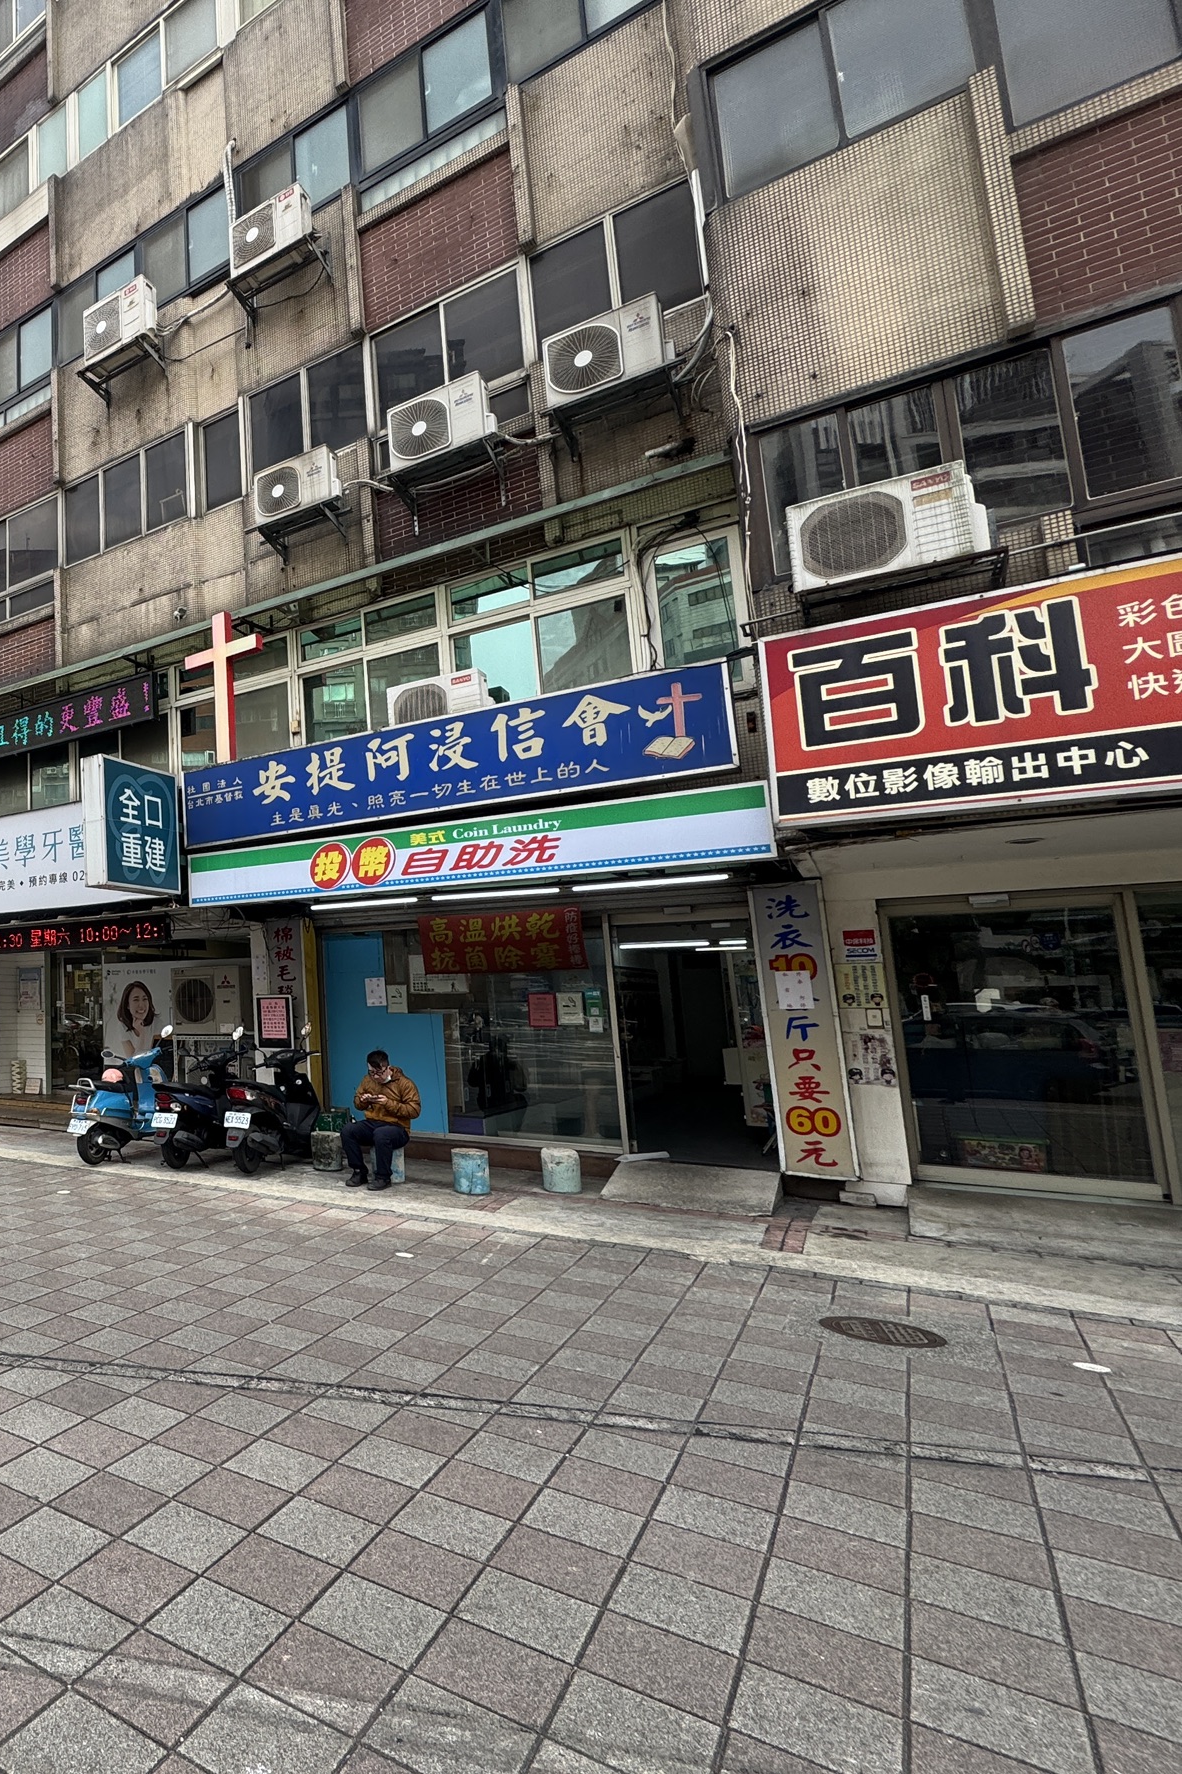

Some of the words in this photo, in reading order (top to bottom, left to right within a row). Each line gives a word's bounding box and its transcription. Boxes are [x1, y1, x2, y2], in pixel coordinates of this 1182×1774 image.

[452, 675, 471, 684] SANYO
[787, 595, 1097, 751] 百科
[1127, 668, 1182, 700] 快
[252, 694, 630, 805] 安提阿浸信會
[187, 776, 243, 795] 社團法人
[807, 741, 1150, 804] 數位影像輸出中心
[118, 788, 163, 830] 全口
[409, 828, 446, 846] 美式
[452, 825, 489, 840] Coin
[492, 817, 562, 837] Laundry
[120, 832, 166, 874] 重建
[315, 844, 391, 882] 投幣
[400, 835, 562, 877] 自助洗
[30, 928, 70, 948] 星期六
[429, 912, 561, 944] 高溫烘乾
[431, 942, 562, 971] 抗菌除霉
